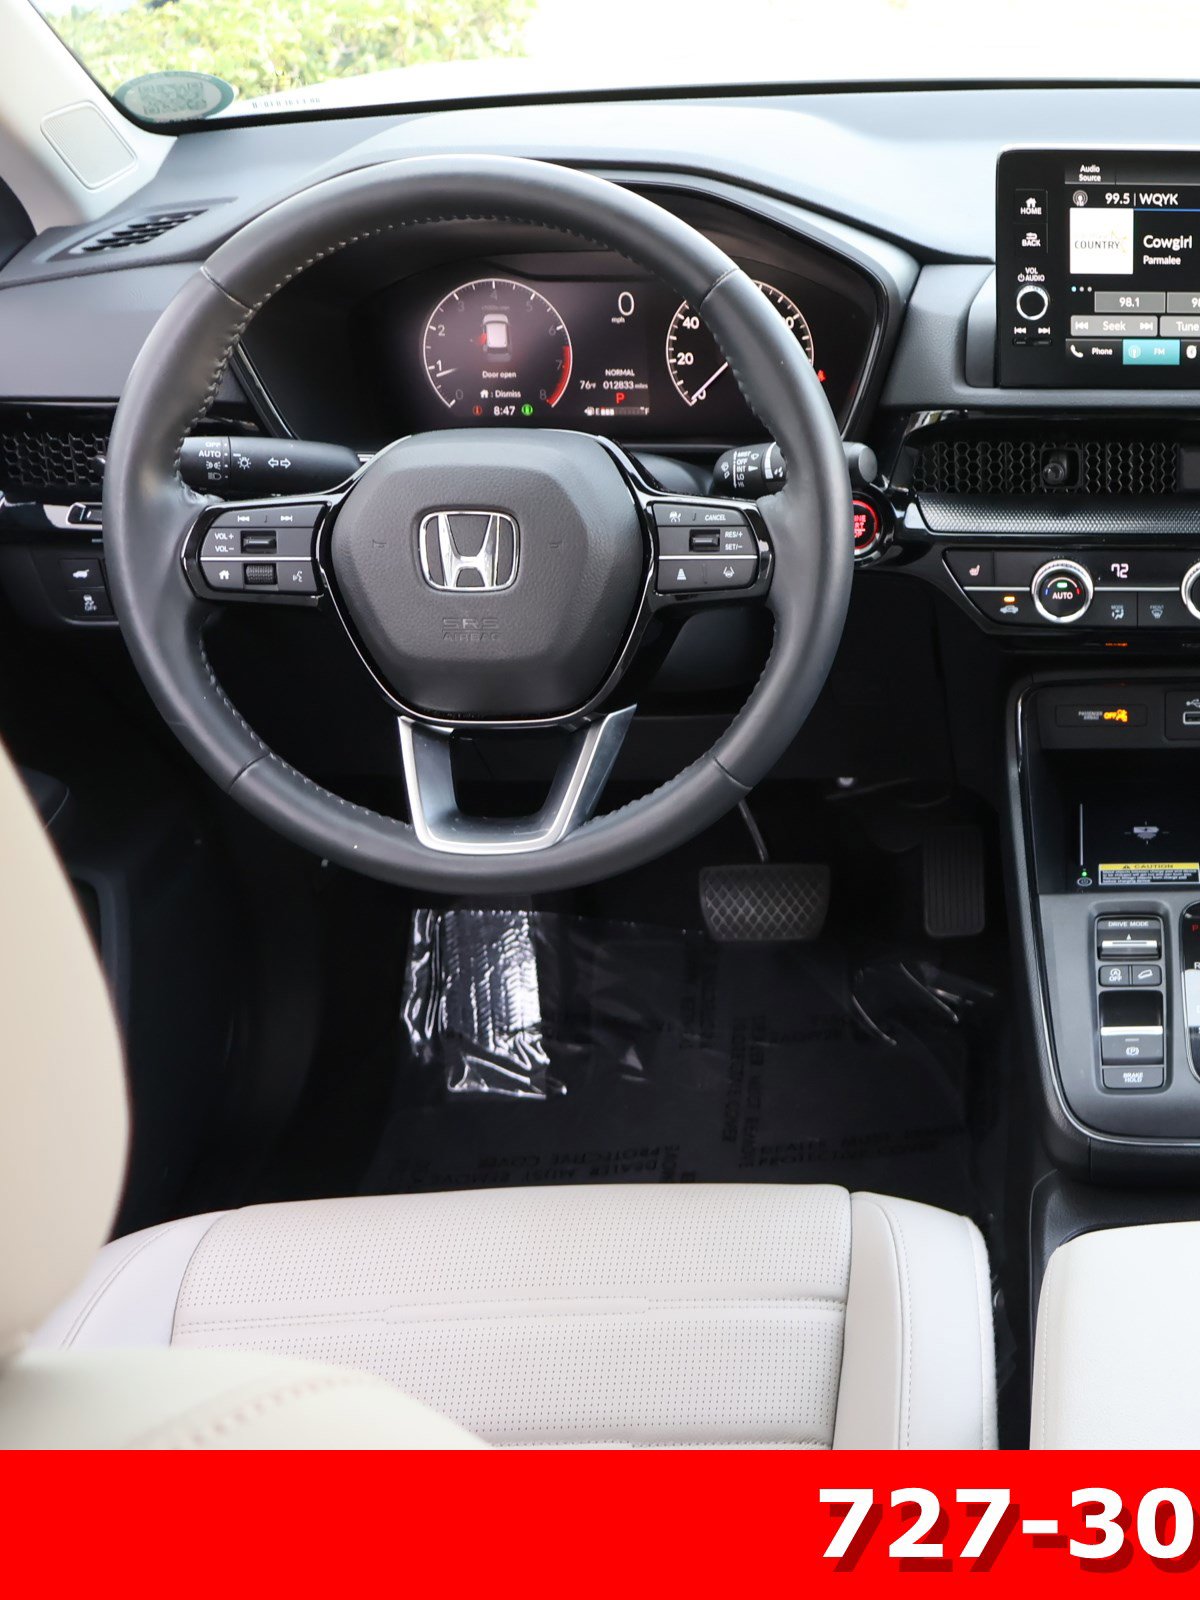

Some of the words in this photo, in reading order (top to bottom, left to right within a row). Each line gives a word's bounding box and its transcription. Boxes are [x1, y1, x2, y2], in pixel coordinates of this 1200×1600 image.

[1080, 165, 1100, 173] Audio
[1105, 192, 1130, 205] 99.5
[1139, 193, 1178, 206] WQYK
[1020, 207, 1042, 215] HOME
[1074, 241, 1120, 249] COUNTRY
[1143, 235, 1192, 250] Cowgirl
[1143, 256, 1181, 265] Parmalee
[618, 291, 635, 316] 0
[1119, 297, 1140, 307] 98.1
[683, 317, 699, 329] 40
[1102, 321, 1126, 330] Seek
[1176, 322, 1199, 331] Tune
[438, 325, 445, 336] 2
[549, 326, 556, 336] 6
[677, 353, 694, 365] 20
[437, 360, 442, 371] 1
[603, 381, 634, 389] 012833
[495, 390, 521, 398] Dismiss
[616, 392, 625, 404] P
[494, 406, 515, 416] 8:47
[1111, 563, 1129, 578] 72
[1052, 592, 1073, 600] AUTO
[442, 618, 499, 630] SRS
[1104, 712, 1118, 720] OFF
[550, 1146, 662, 1167] PROTECTIVE
